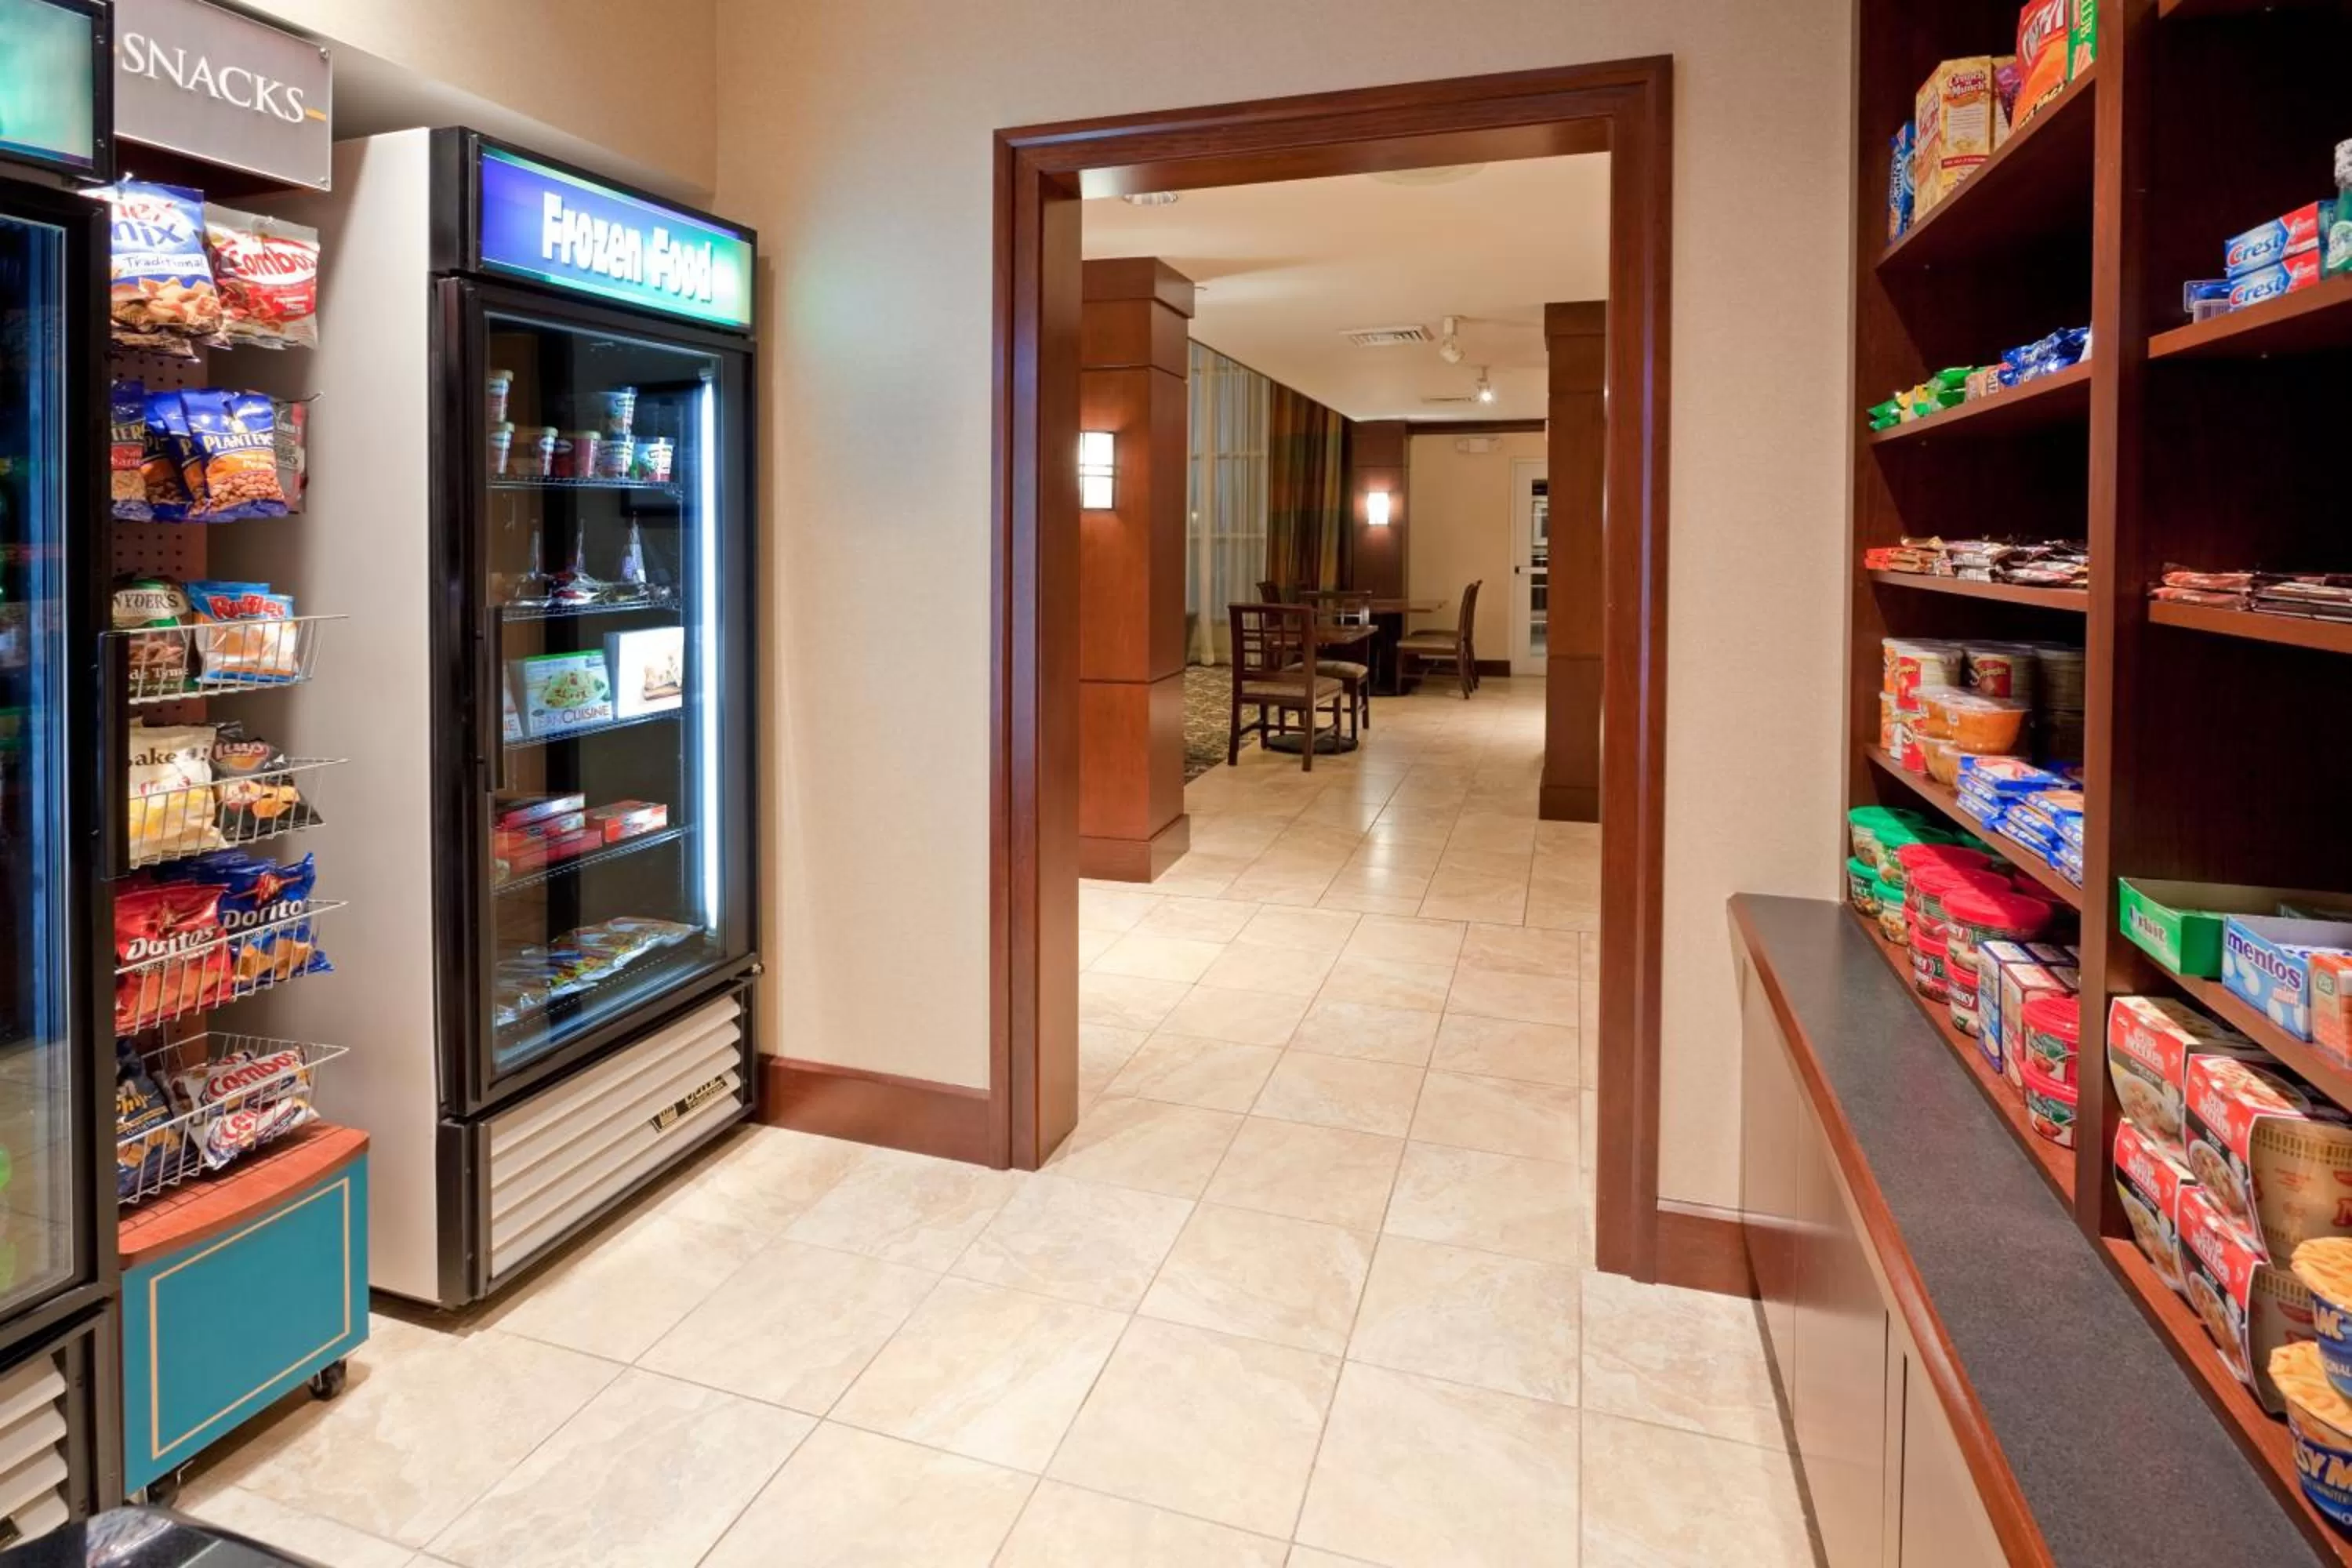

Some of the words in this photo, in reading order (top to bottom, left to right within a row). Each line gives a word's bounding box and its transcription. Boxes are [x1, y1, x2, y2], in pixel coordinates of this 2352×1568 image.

[121, 32, 305, 124] SNACKS
[228, 245, 317, 276] Combos
[543, 191, 644, 285] Frozen
[643, 226, 713, 303] Food
[2227, 230, 2282, 266] Crest
[2230, 274, 2285, 306] Crest
[201, 432, 274, 454] PLANTERS
[113, 592, 178, 612] NYDER'S
[207, 593, 285, 622] Ruffles
[562, 704, 609, 724] CUISINE
[223, 898, 305, 929] Dorito
[125, 926, 216, 960] Doritos
[2227, 931, 2302, 991] mentos
[207, 1052, 293, 1096] Combos
